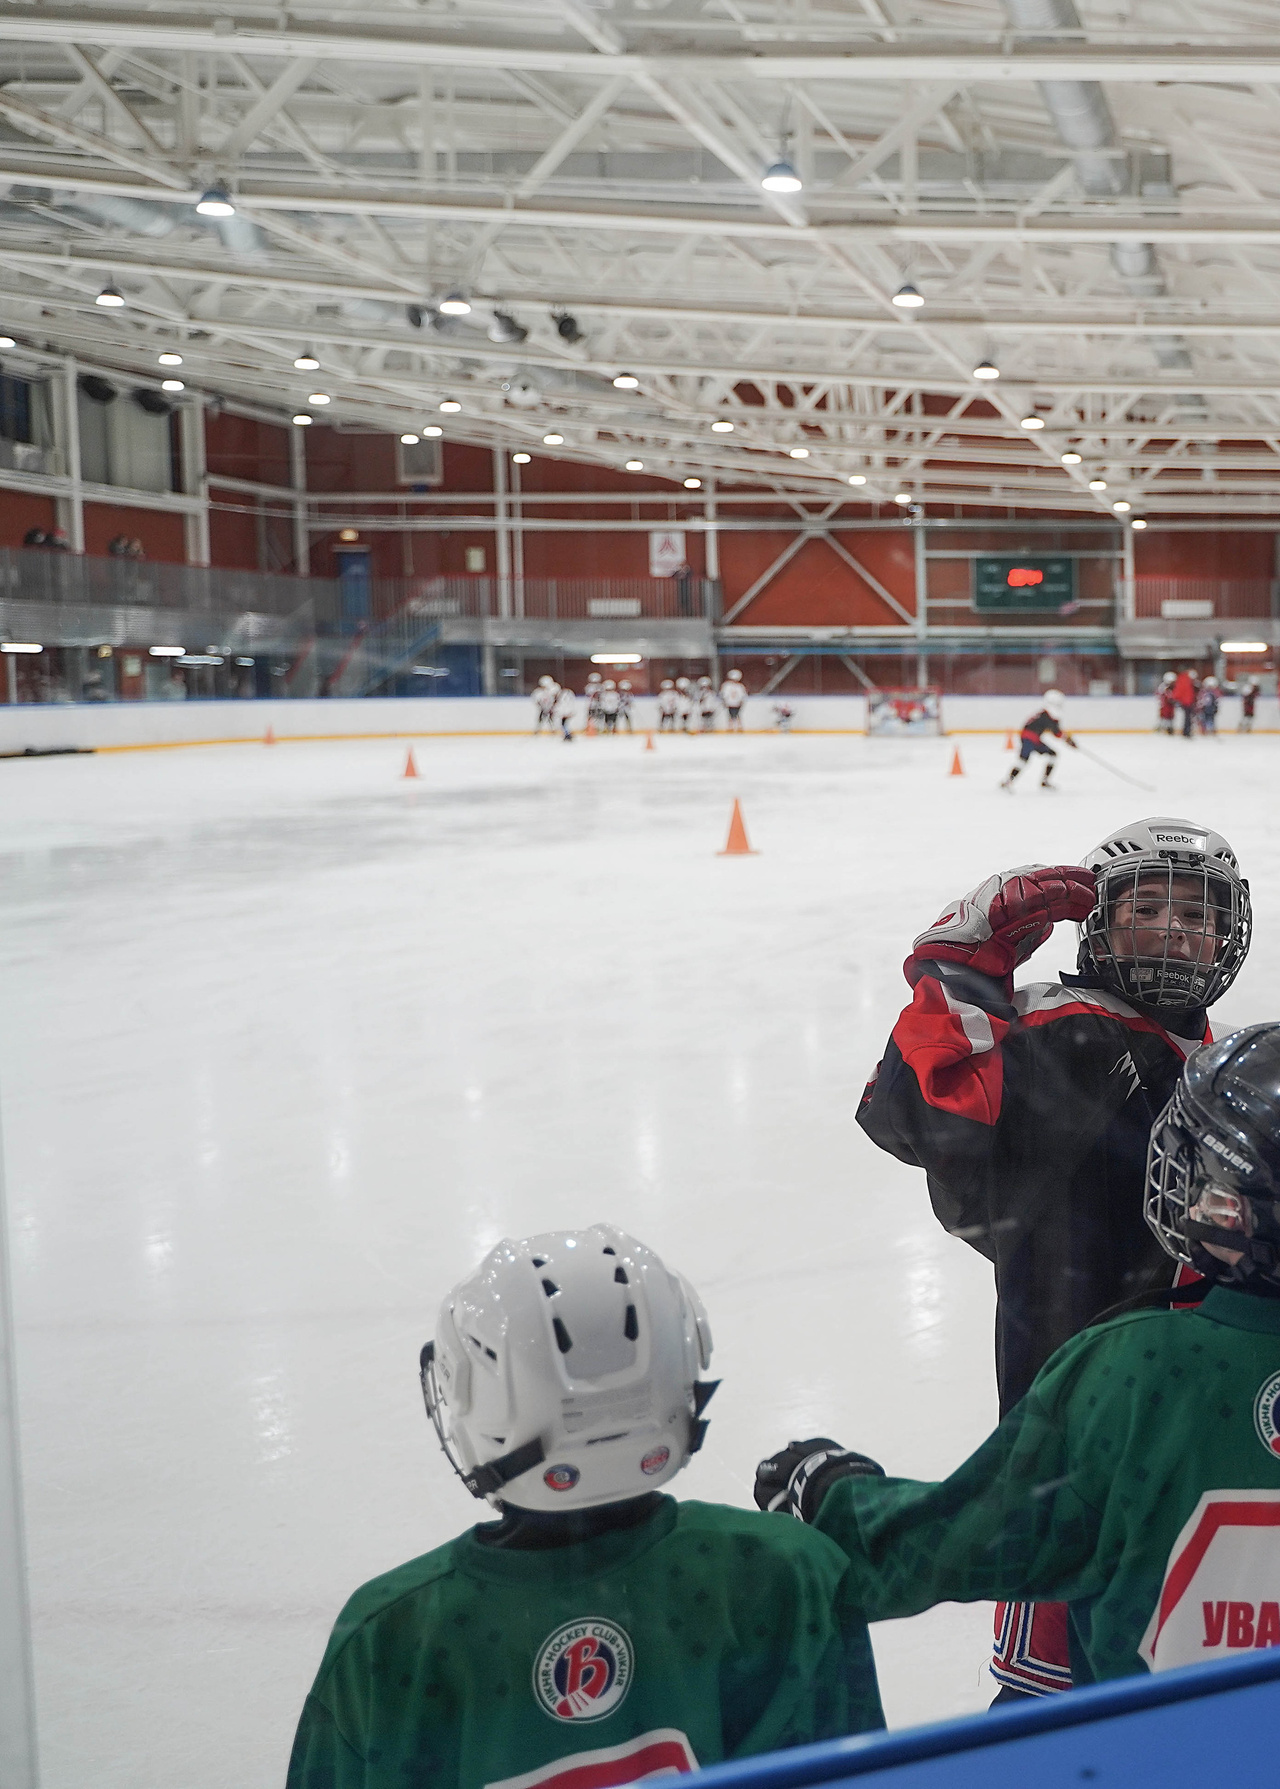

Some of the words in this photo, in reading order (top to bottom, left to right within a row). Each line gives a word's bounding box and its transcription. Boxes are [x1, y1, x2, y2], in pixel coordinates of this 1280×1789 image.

[1261, 1403, 1275, 1439] VIKHR
[547, 1626, 588, 1661] HOCKEY
[592, 1627, 619, 1645] CLUB
[615, 1647, 627, 1688] VIKHR
[541, 1669, 559, 1706] VIKHR
